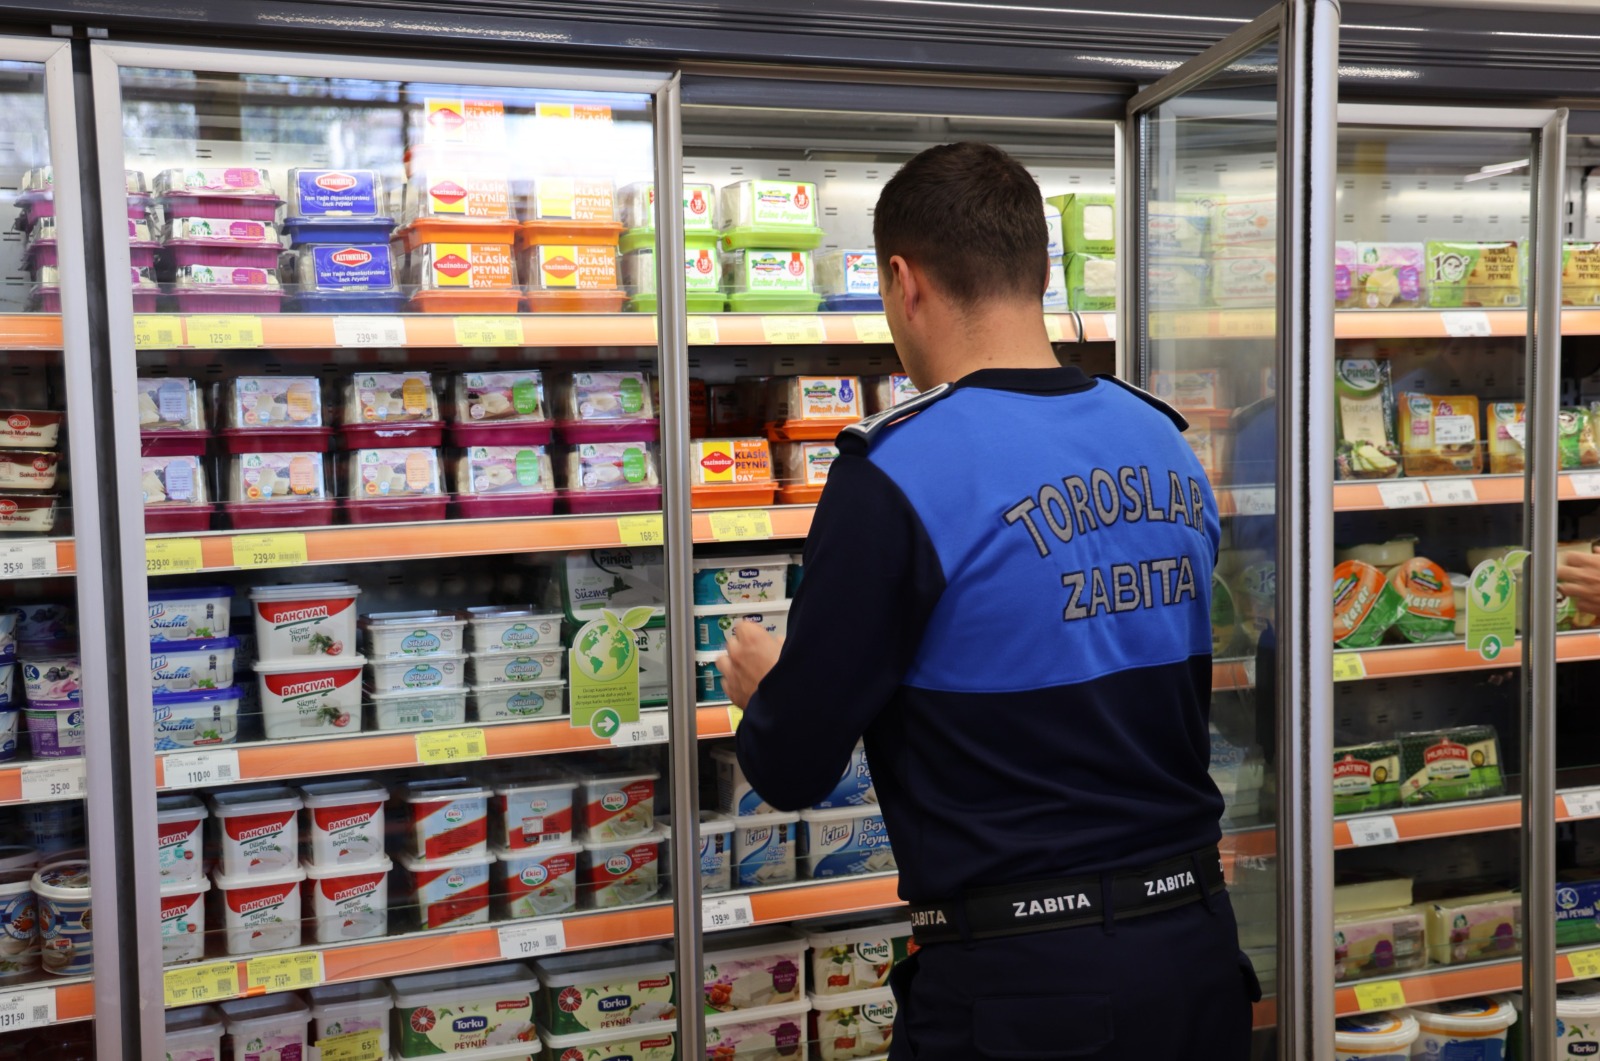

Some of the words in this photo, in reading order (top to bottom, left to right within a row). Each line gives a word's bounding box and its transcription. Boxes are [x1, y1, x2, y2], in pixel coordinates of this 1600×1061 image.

[468, 192, 506, 203] PEYNİR
[575, 196, 611, 207] PEYNİR
[336, 252, 368, 262] ALTINKILIÇ
[472, 253, 509, 264] KLASİK
[579, 255, 614, 265] KLASİK
[473, 263, 510, 275] PEYNİR
[579, 264, 615, 275] PEYNİR
[735, 449, 768, 460] KLASİK
[735, 459, 769, 469] PEYNİR
[1001, 466, 1206, 559] TOROSLAR
[253, 552, 276, 565] 239.00
[727, 580, 752, 591] Süzme
[1061, 555, 1197, 622] ZABITA
[575, 588, 608, 600] Süzme
[1405, 593, 1442, 609] Kaşar
[273, 605, 327, 623] BAHÇIVAN
[151, 617, 189, 629] Süzme
[289, 626, 311, 636] Süzme
[291, 632, 311, 643] Peynir
[153, 670, 191, 681] Süzme
[282, 678, 334, 697] BAHÇIVAN
[296, 698, 318, 708] Süzme
[157, 720, 196, 732] Süzme
[1427, 748, 1467, 760] MURATBEY
[606, 795, 623, 804] Ekici
[745, 827, 769, 846] İçim
[820, 824, 848, 846] İçim
[610, 858, 627, 867] Ekici
[525, 869, 542, 878] Ekici
[1144, 870, 1195, 897] ZABITA
[1012, 893, 1091, 917] ZABITA
[911, 909, 947, 927] ZABITA
[520, 941, 540, 953] 127.50
[862, 945, 888, 956] PINAR
[601, 998, 628, 1009] Torku
[867, 1007, 893, 1017] PINAR
[455, 1019, 484, 1030] Torku
[600, 1016, 632, 1029] PEYNİR
[454, 1038, 488, 1050] PEYNİR
[1571, 1043, 1597, 1053] Torku
